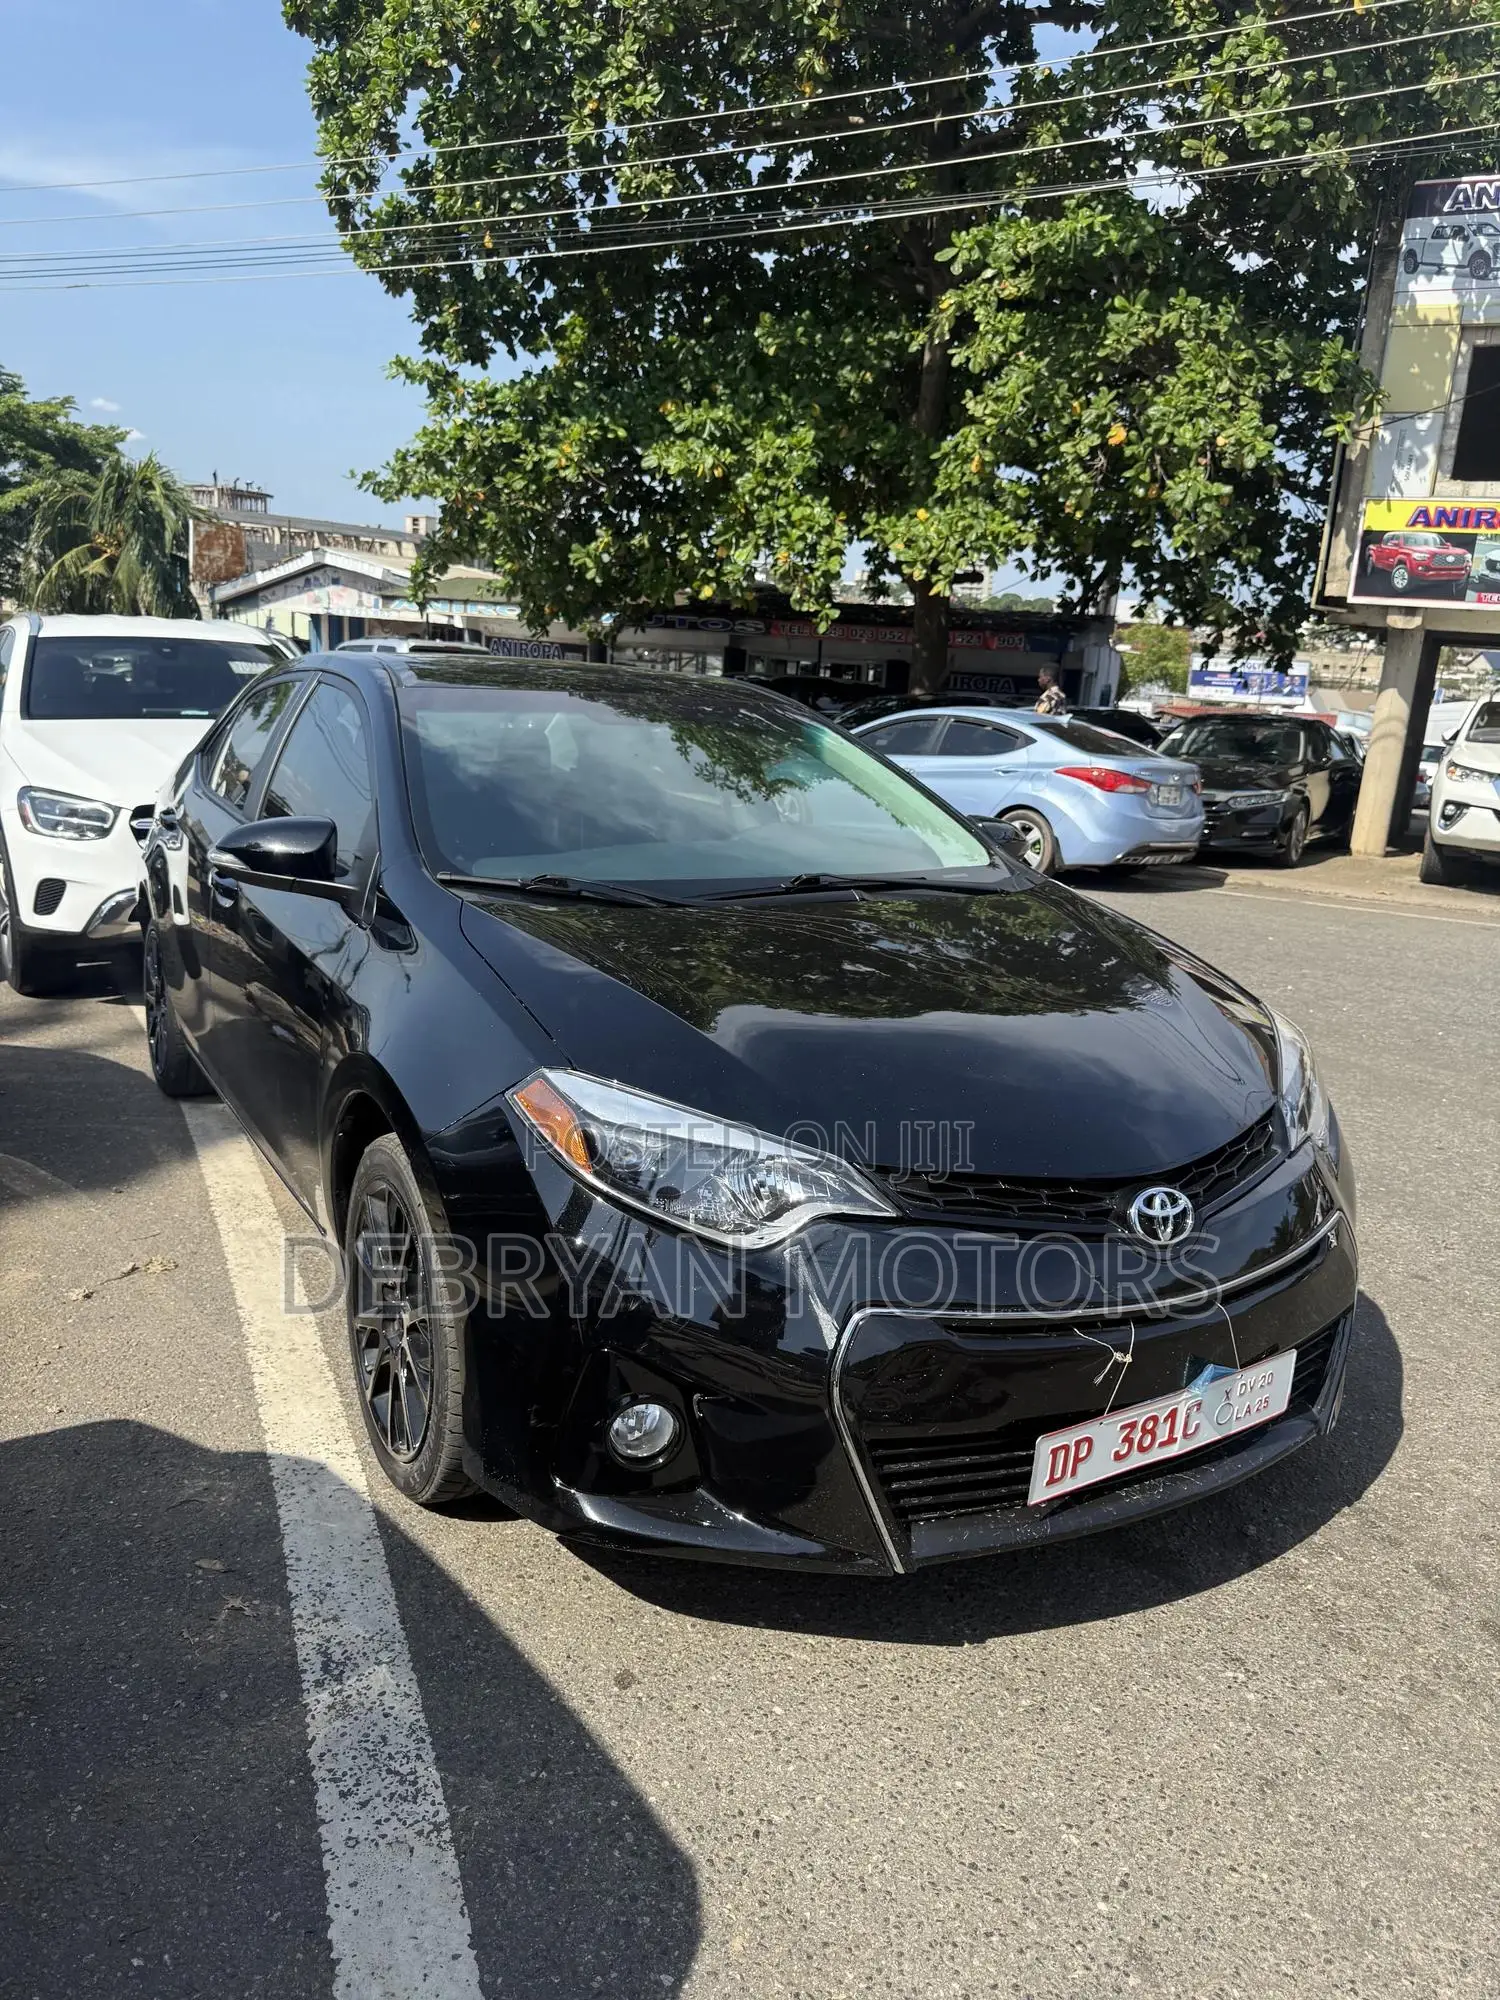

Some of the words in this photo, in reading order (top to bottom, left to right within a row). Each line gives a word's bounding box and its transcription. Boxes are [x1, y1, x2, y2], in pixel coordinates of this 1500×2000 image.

[1407, 506, 1500, 529] ANIR
[490, 638, 563, 660] ANIROPA
[1236, 1378, 1256, 1397] DV
[1257, 1370, 1274, 1389] 20
[1254, 1393, 1270, 1413] 25
[1044, 1435, 1094, 1488] DP
